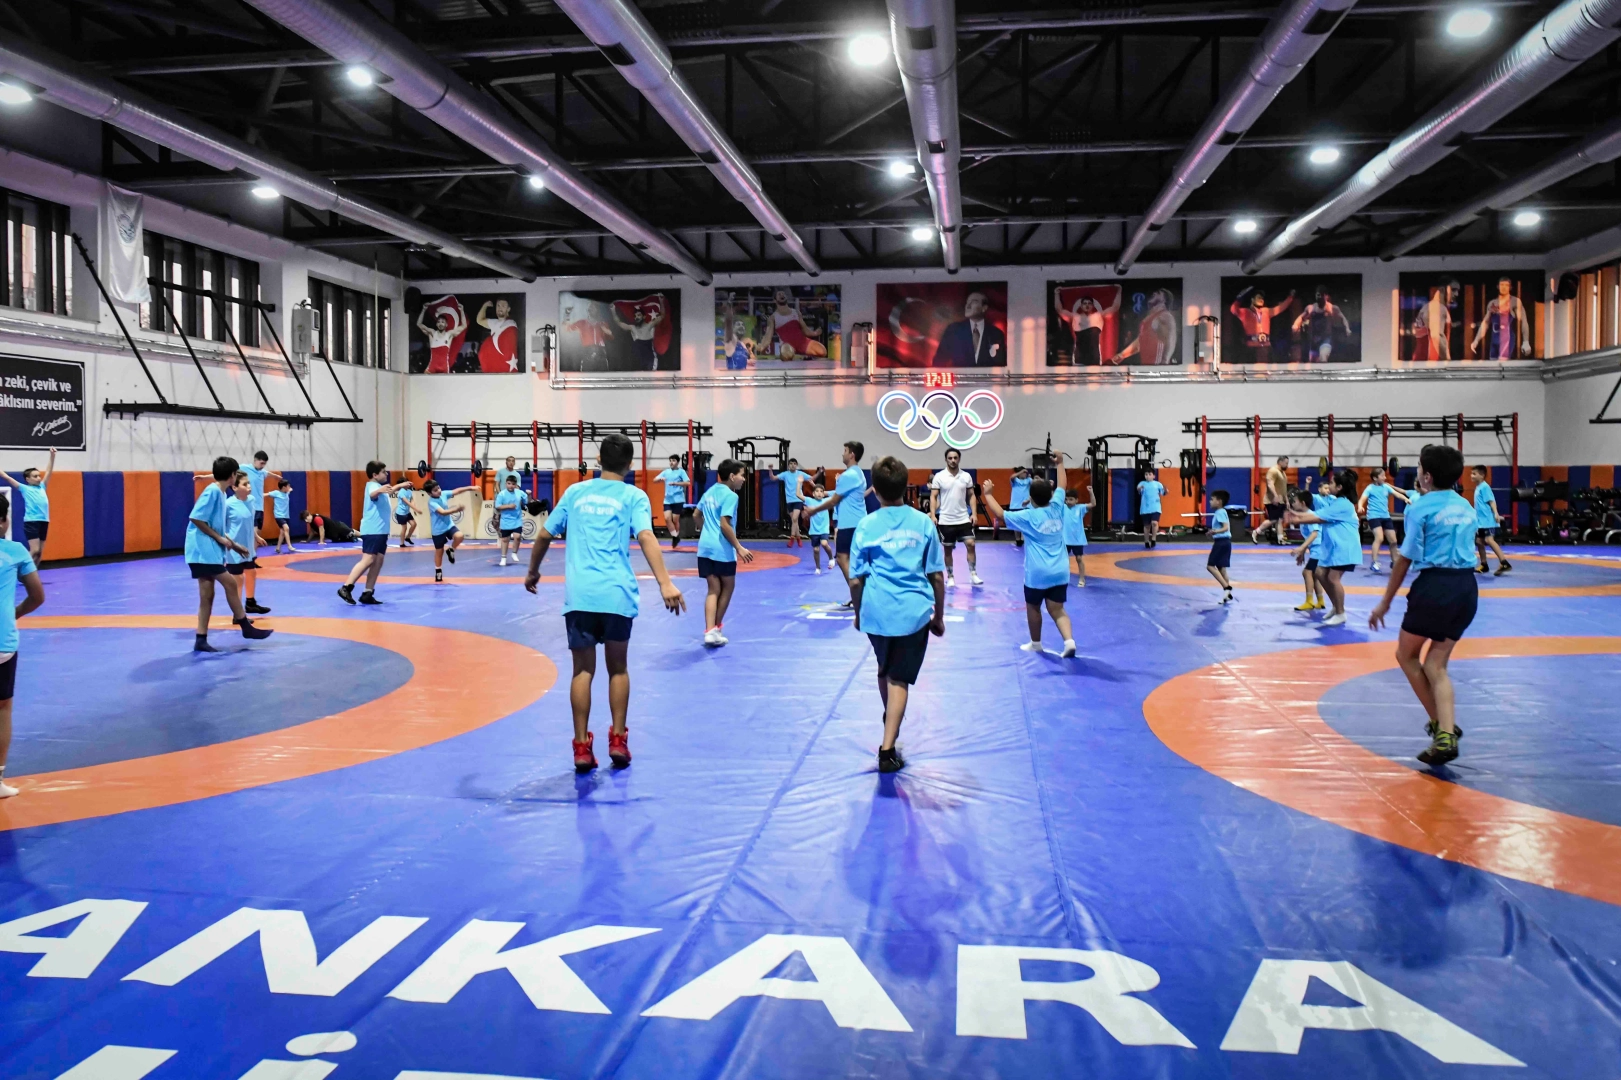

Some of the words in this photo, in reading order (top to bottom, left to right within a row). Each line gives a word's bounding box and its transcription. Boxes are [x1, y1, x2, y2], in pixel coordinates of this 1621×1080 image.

[4, 375, 30, 391] zeki,
[31, 377, 59, 392] çevik
[59, 381, 72, 393] ve
[926, 372, 953, 387] 17:11
[0, 898, 1527, 1067] ANKARA
